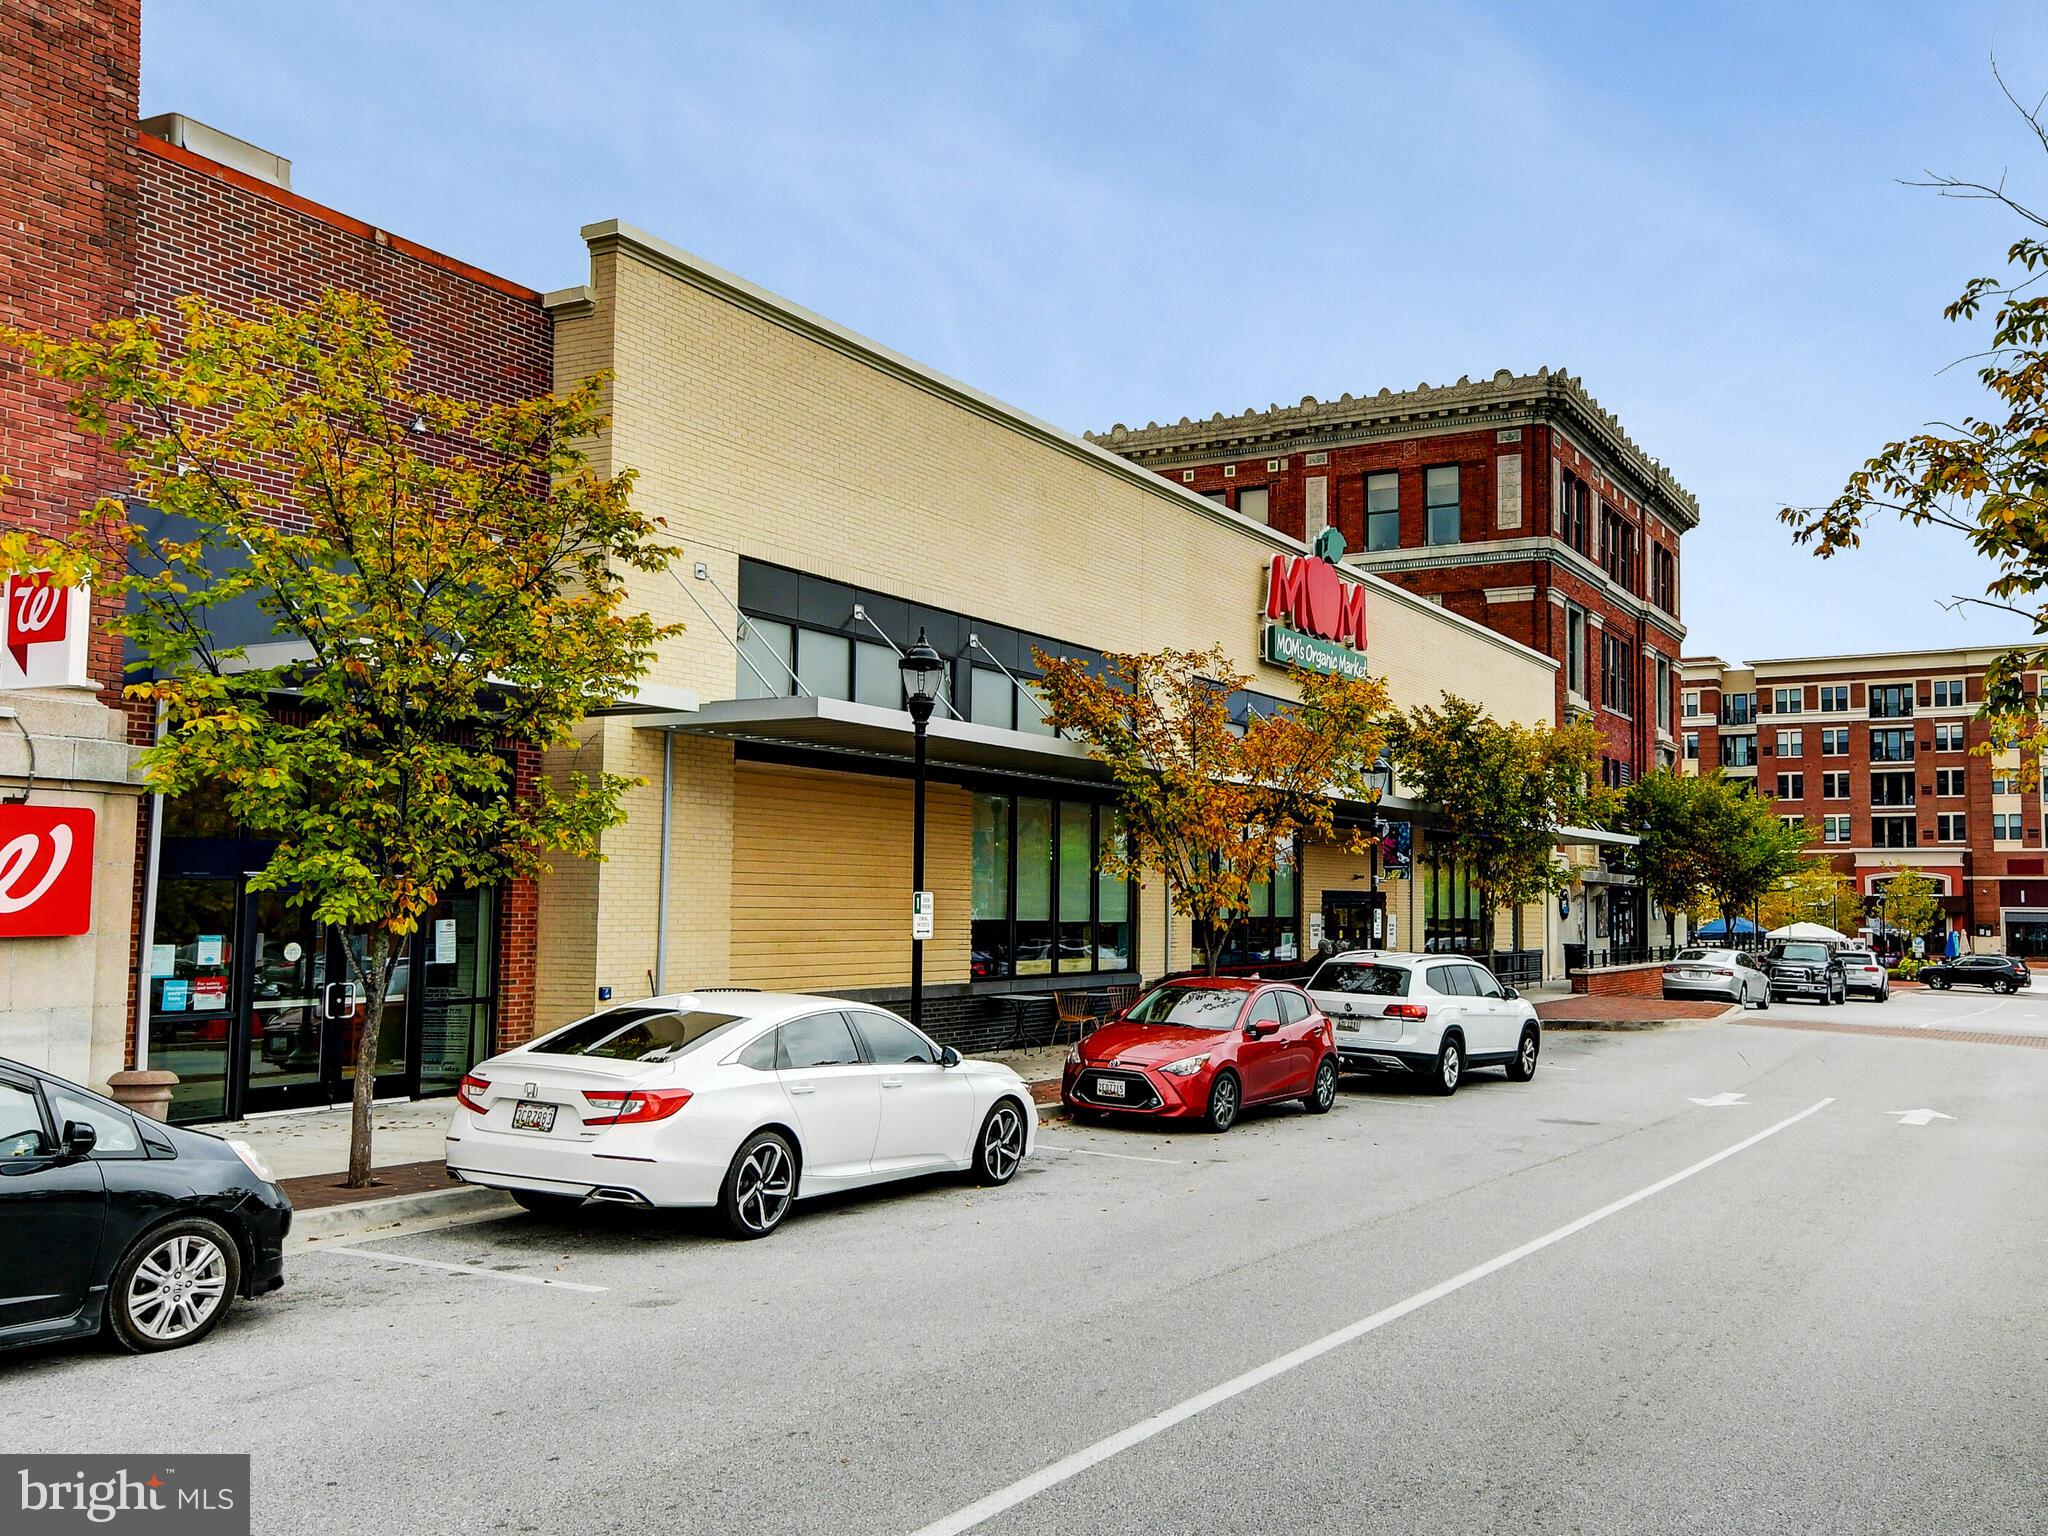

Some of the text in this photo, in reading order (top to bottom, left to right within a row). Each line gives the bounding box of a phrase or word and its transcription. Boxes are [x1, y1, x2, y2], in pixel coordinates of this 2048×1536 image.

[1276, 633, 1368, 679] MOM's Organic Market
